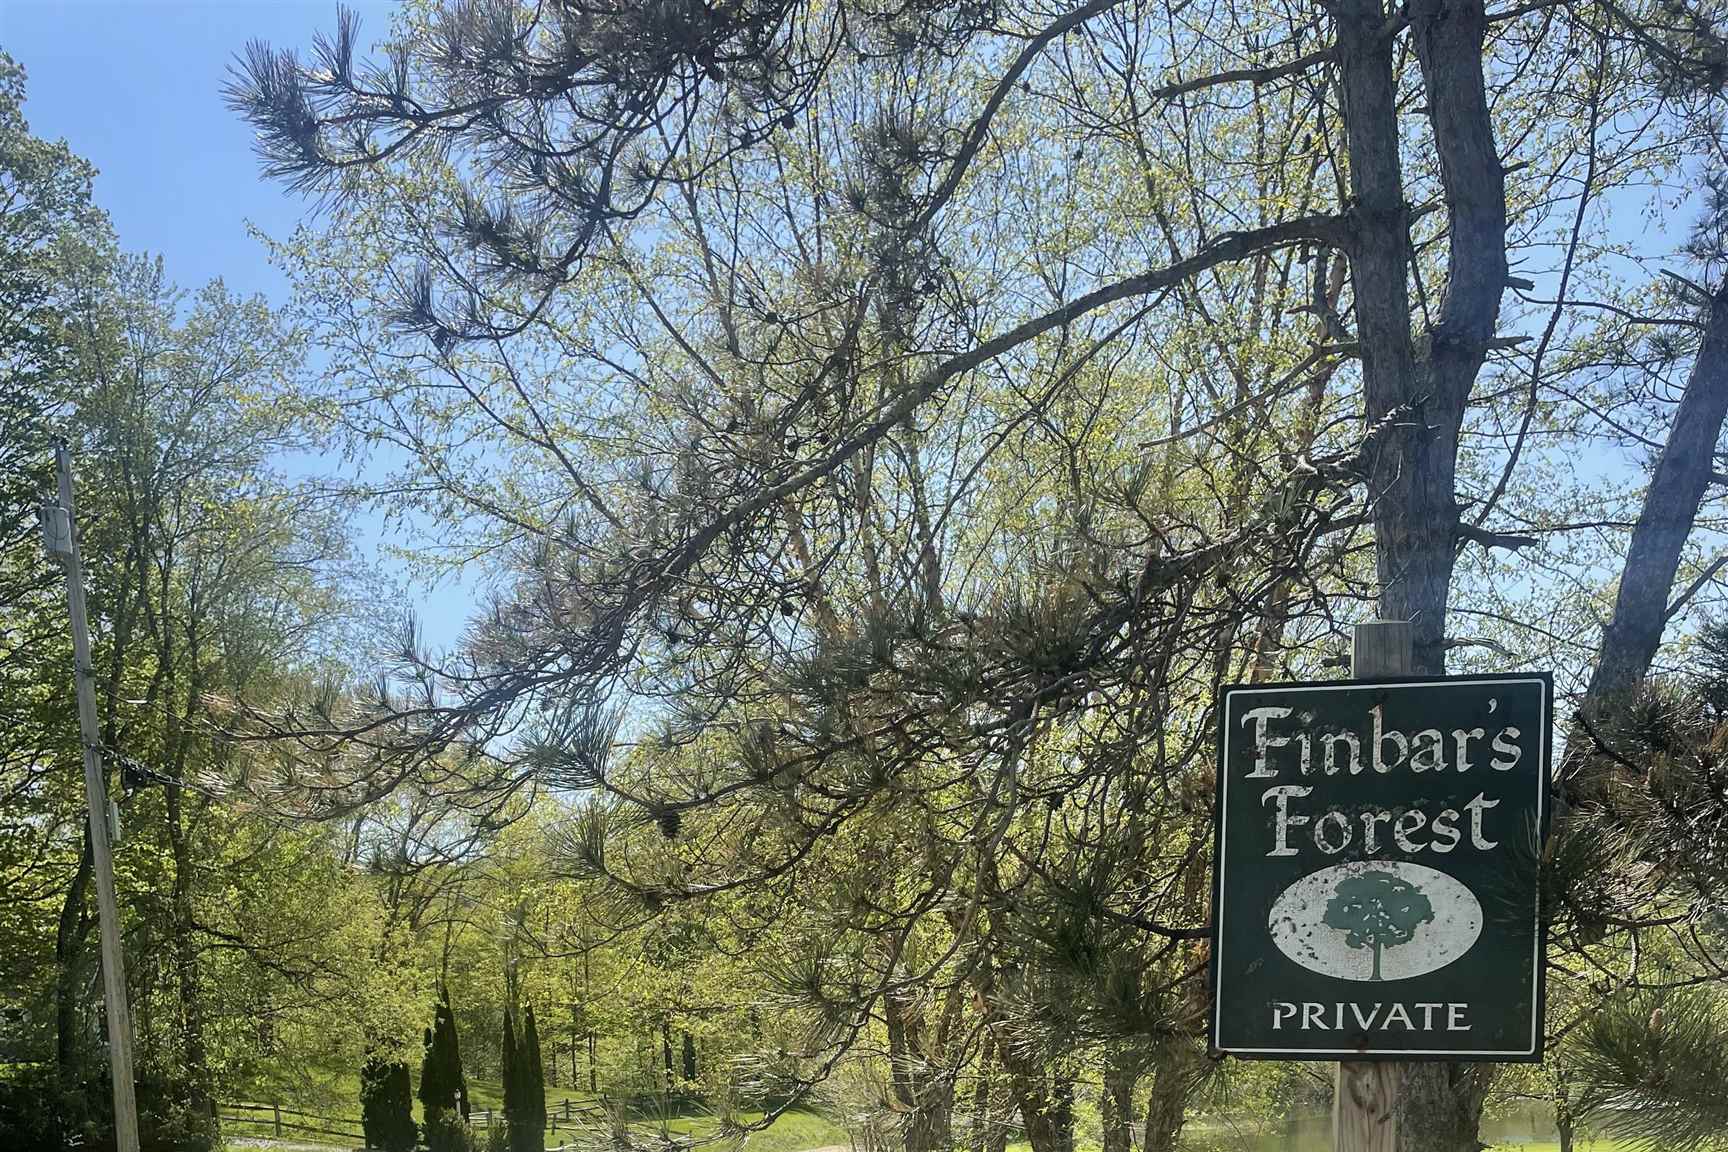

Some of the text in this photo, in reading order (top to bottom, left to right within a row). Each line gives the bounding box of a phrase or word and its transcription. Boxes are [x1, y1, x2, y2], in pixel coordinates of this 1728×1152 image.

[1240, 698, 1522, 779] Finbar's
[1261, 785, 1500, 857] Forest
[1271, 1001, 1473, 1032] PRIVATE
